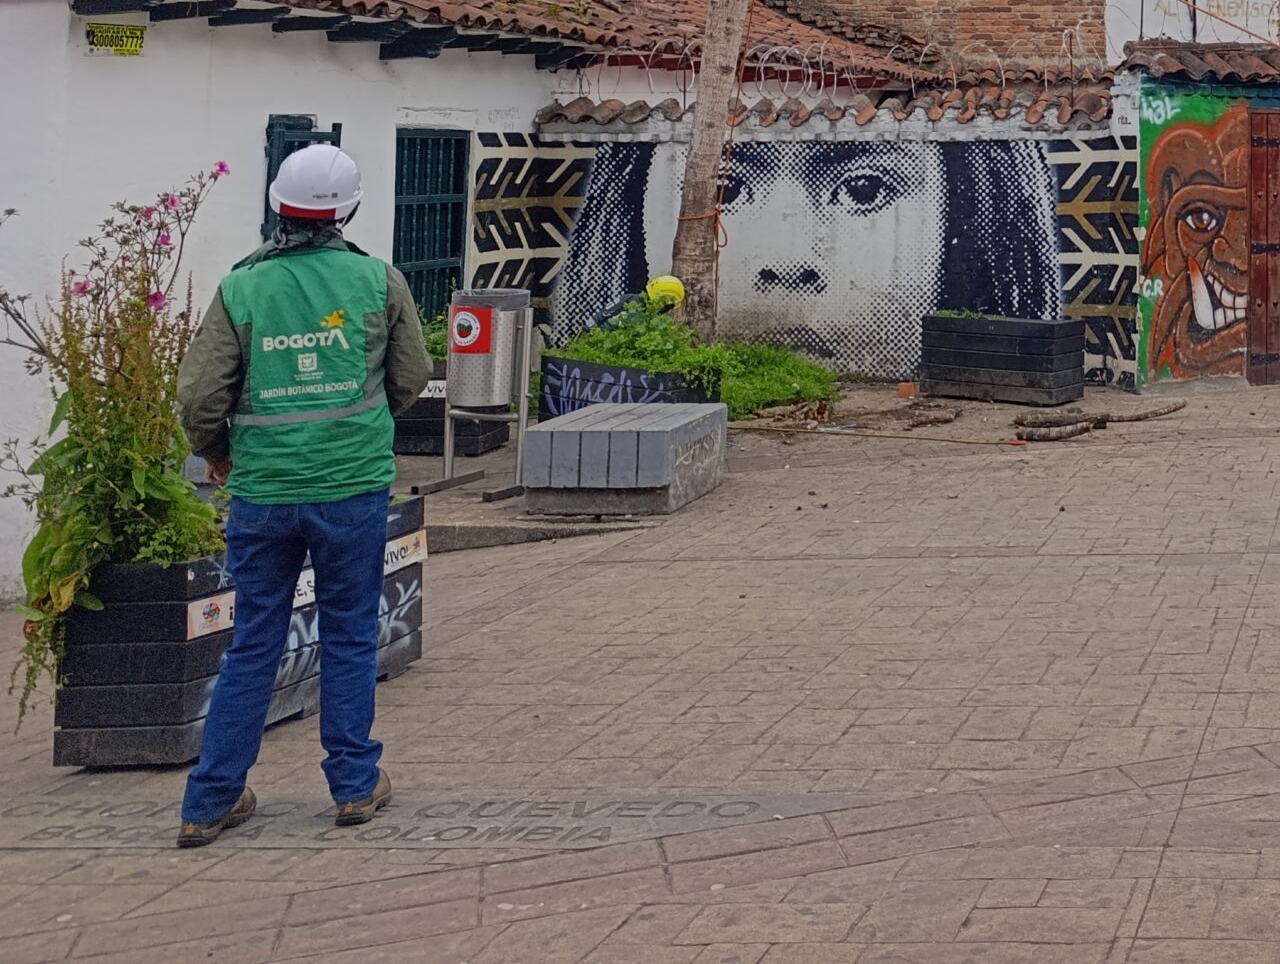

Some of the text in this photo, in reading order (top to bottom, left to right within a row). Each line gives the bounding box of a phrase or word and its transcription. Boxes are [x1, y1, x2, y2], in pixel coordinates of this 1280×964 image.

[259, 378, 358, 399] JARDÍN BOTÁNICO BOGOTÁ
[413, 801, 761, 819] QUEVEDO
[314, 825, 612, 842] COLOMBIA
